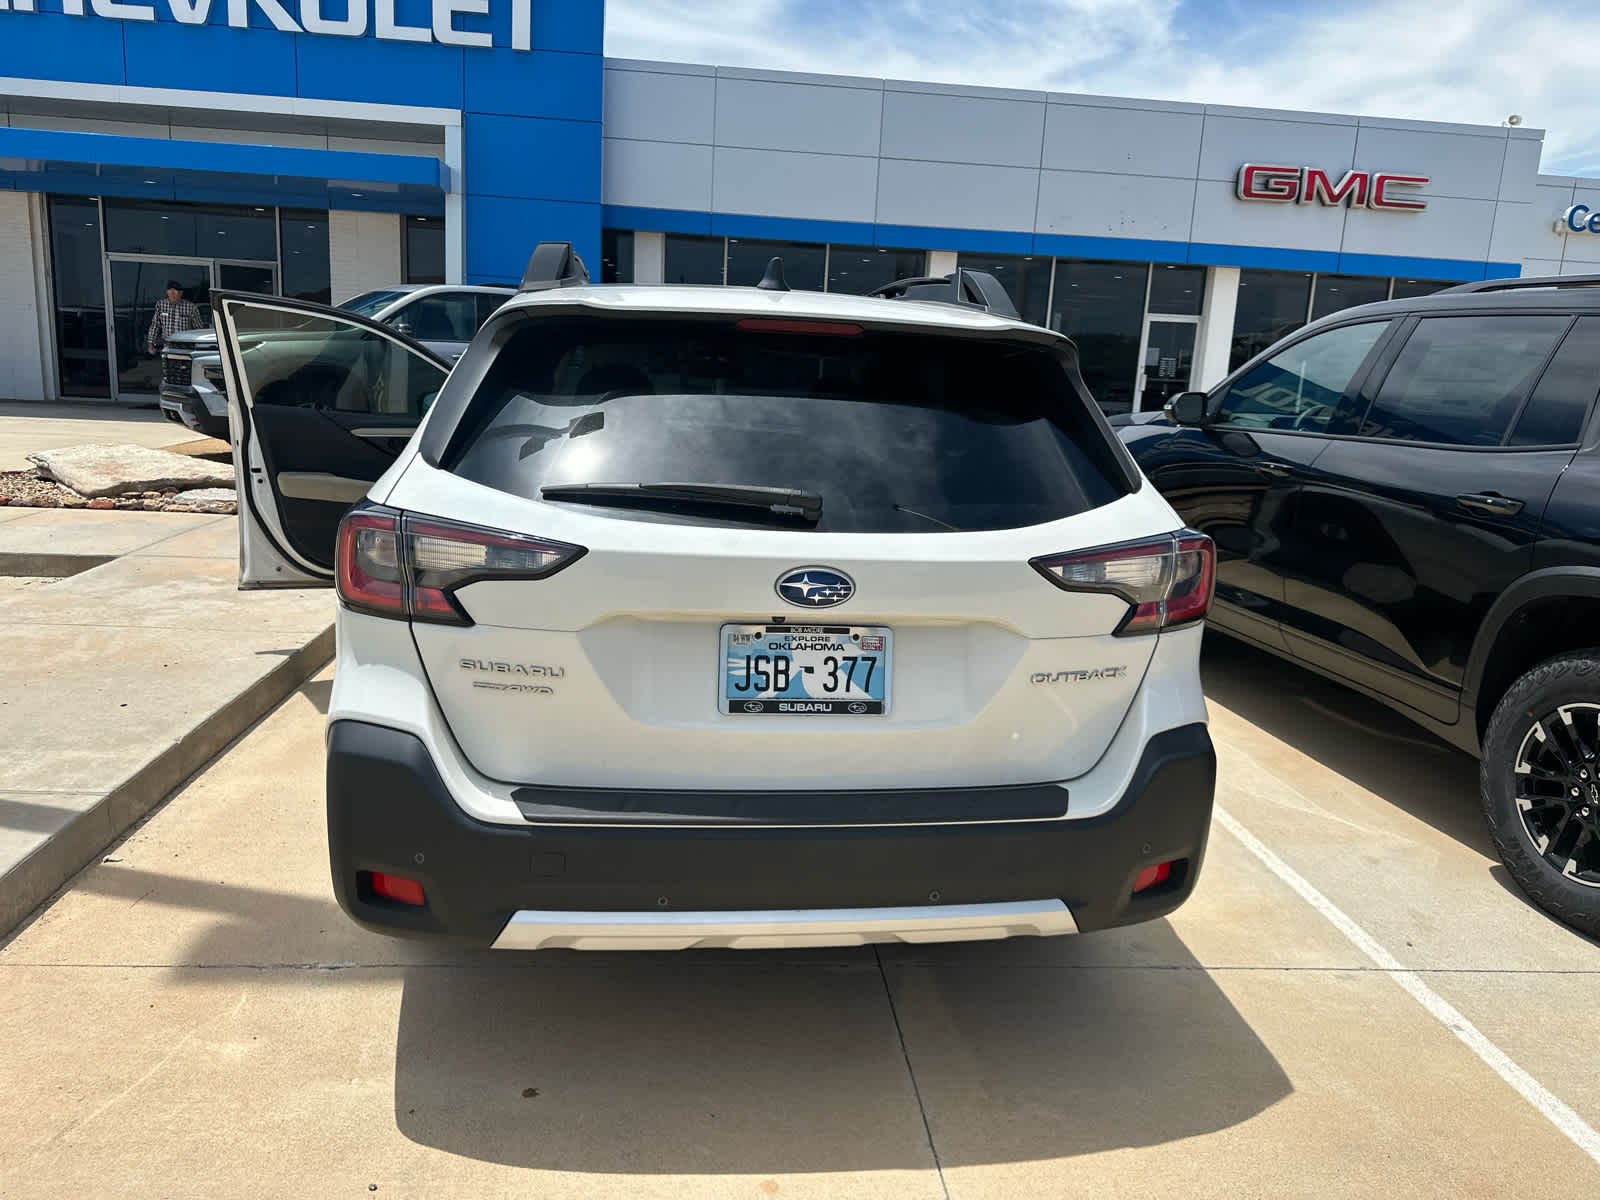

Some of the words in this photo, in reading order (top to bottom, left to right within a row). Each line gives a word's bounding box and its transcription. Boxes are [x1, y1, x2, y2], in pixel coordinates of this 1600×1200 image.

[1237, 163, 1431, 213] GMC
[768, 642, 845, 652] OKLAHOMA
[459, 658, 565, 678] SUBARU
[734, 655, 790, 692] JSB
[823, 656, 877, 693] 377
[1030, 665, 1128, 684] OUTBACK
[503, 684, 554, 696] AWD
[778, 702, 833, 712] SUBARU
